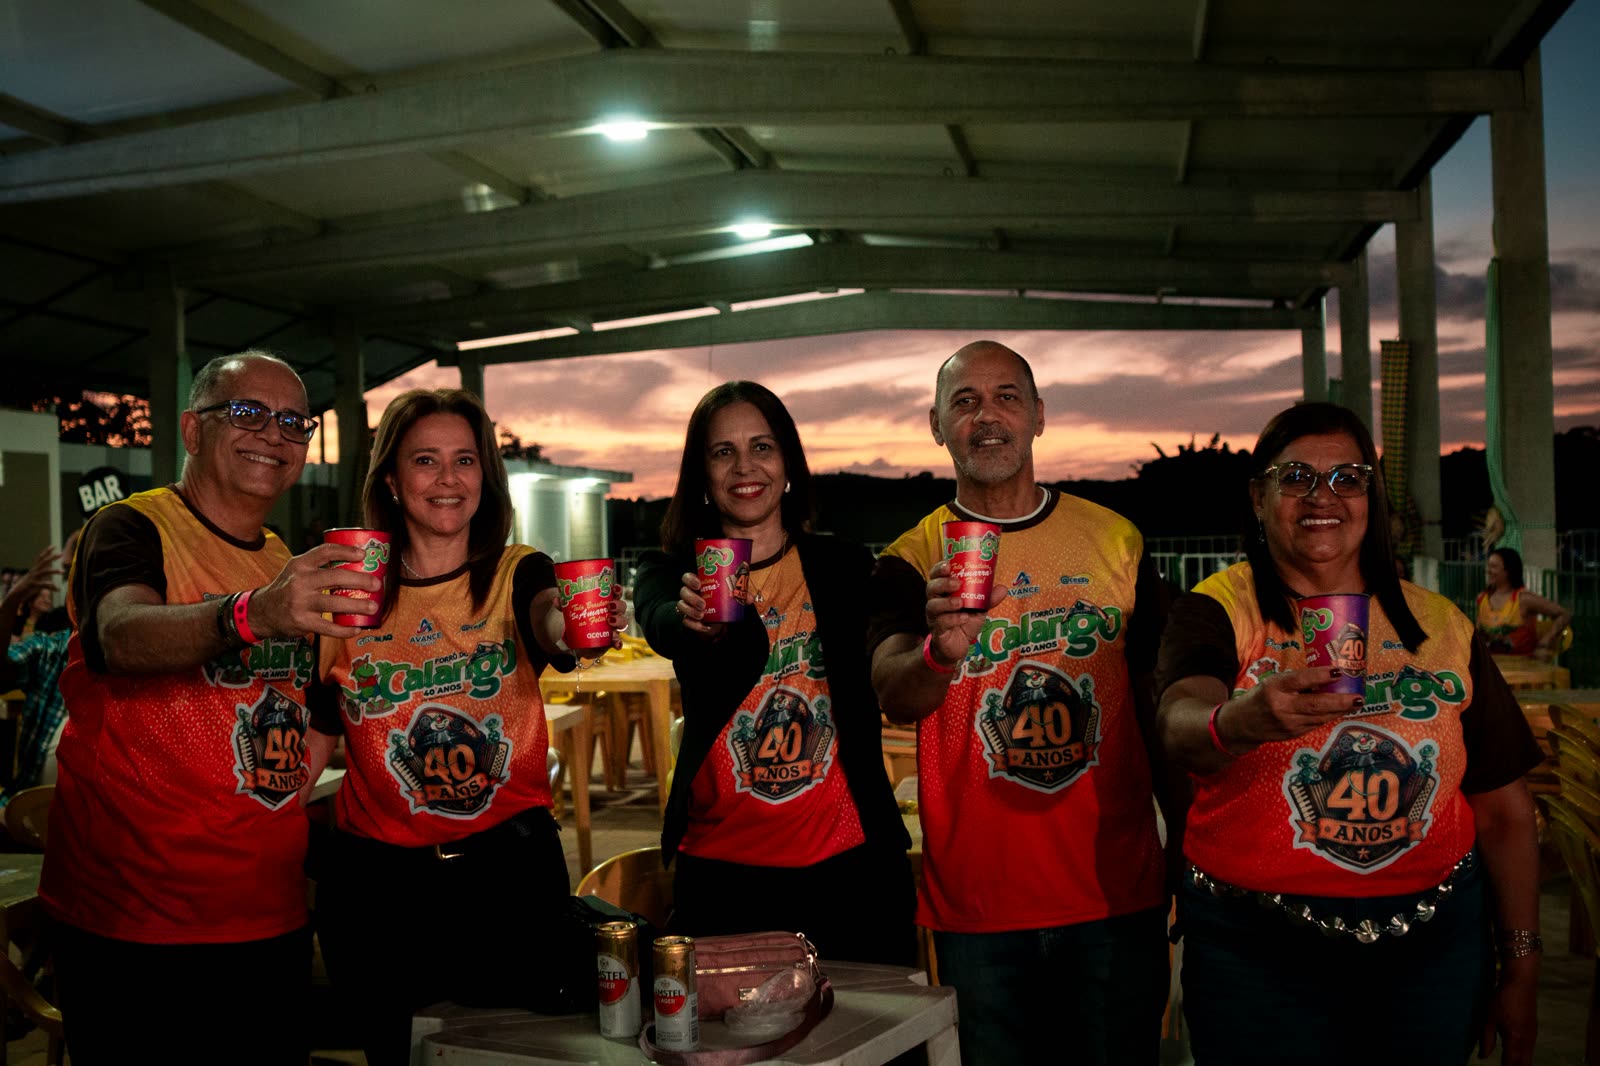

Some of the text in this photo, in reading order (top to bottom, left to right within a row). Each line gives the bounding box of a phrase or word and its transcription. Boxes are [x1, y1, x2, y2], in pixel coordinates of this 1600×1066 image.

[78, 474, 124, 513] BAR
[961, 592, 985, 601] acelen
[1055, 607, 1066, 616] DO
[409, 632, 442, 643] AVANCE
[586, 631, 610, 639] acelen
[980, 606, 1122, 662] Calango
[1019, 641, 1057, 654] 40 ANOS
[1340, 639, 1364, 661] 40
[378, 638, 518, 703] Calango
[1382, 671, 1394, 679] DO
[423, 689, 435, 697] 40
[437, 683, 462, 695] ANOS
[1360, 704, 1390, 713] ANOS
[1012, 701, 1072, 748] 40
[264, 727, 303, 770] 40
[758, 721, 803, 763] 40
[424, 743, 476, 785] 40
[1021, 748, 1074, 766] ANOS
[1327, 769, 1400, 821] 40
[1333, 824, 1394, 842] ANOS
